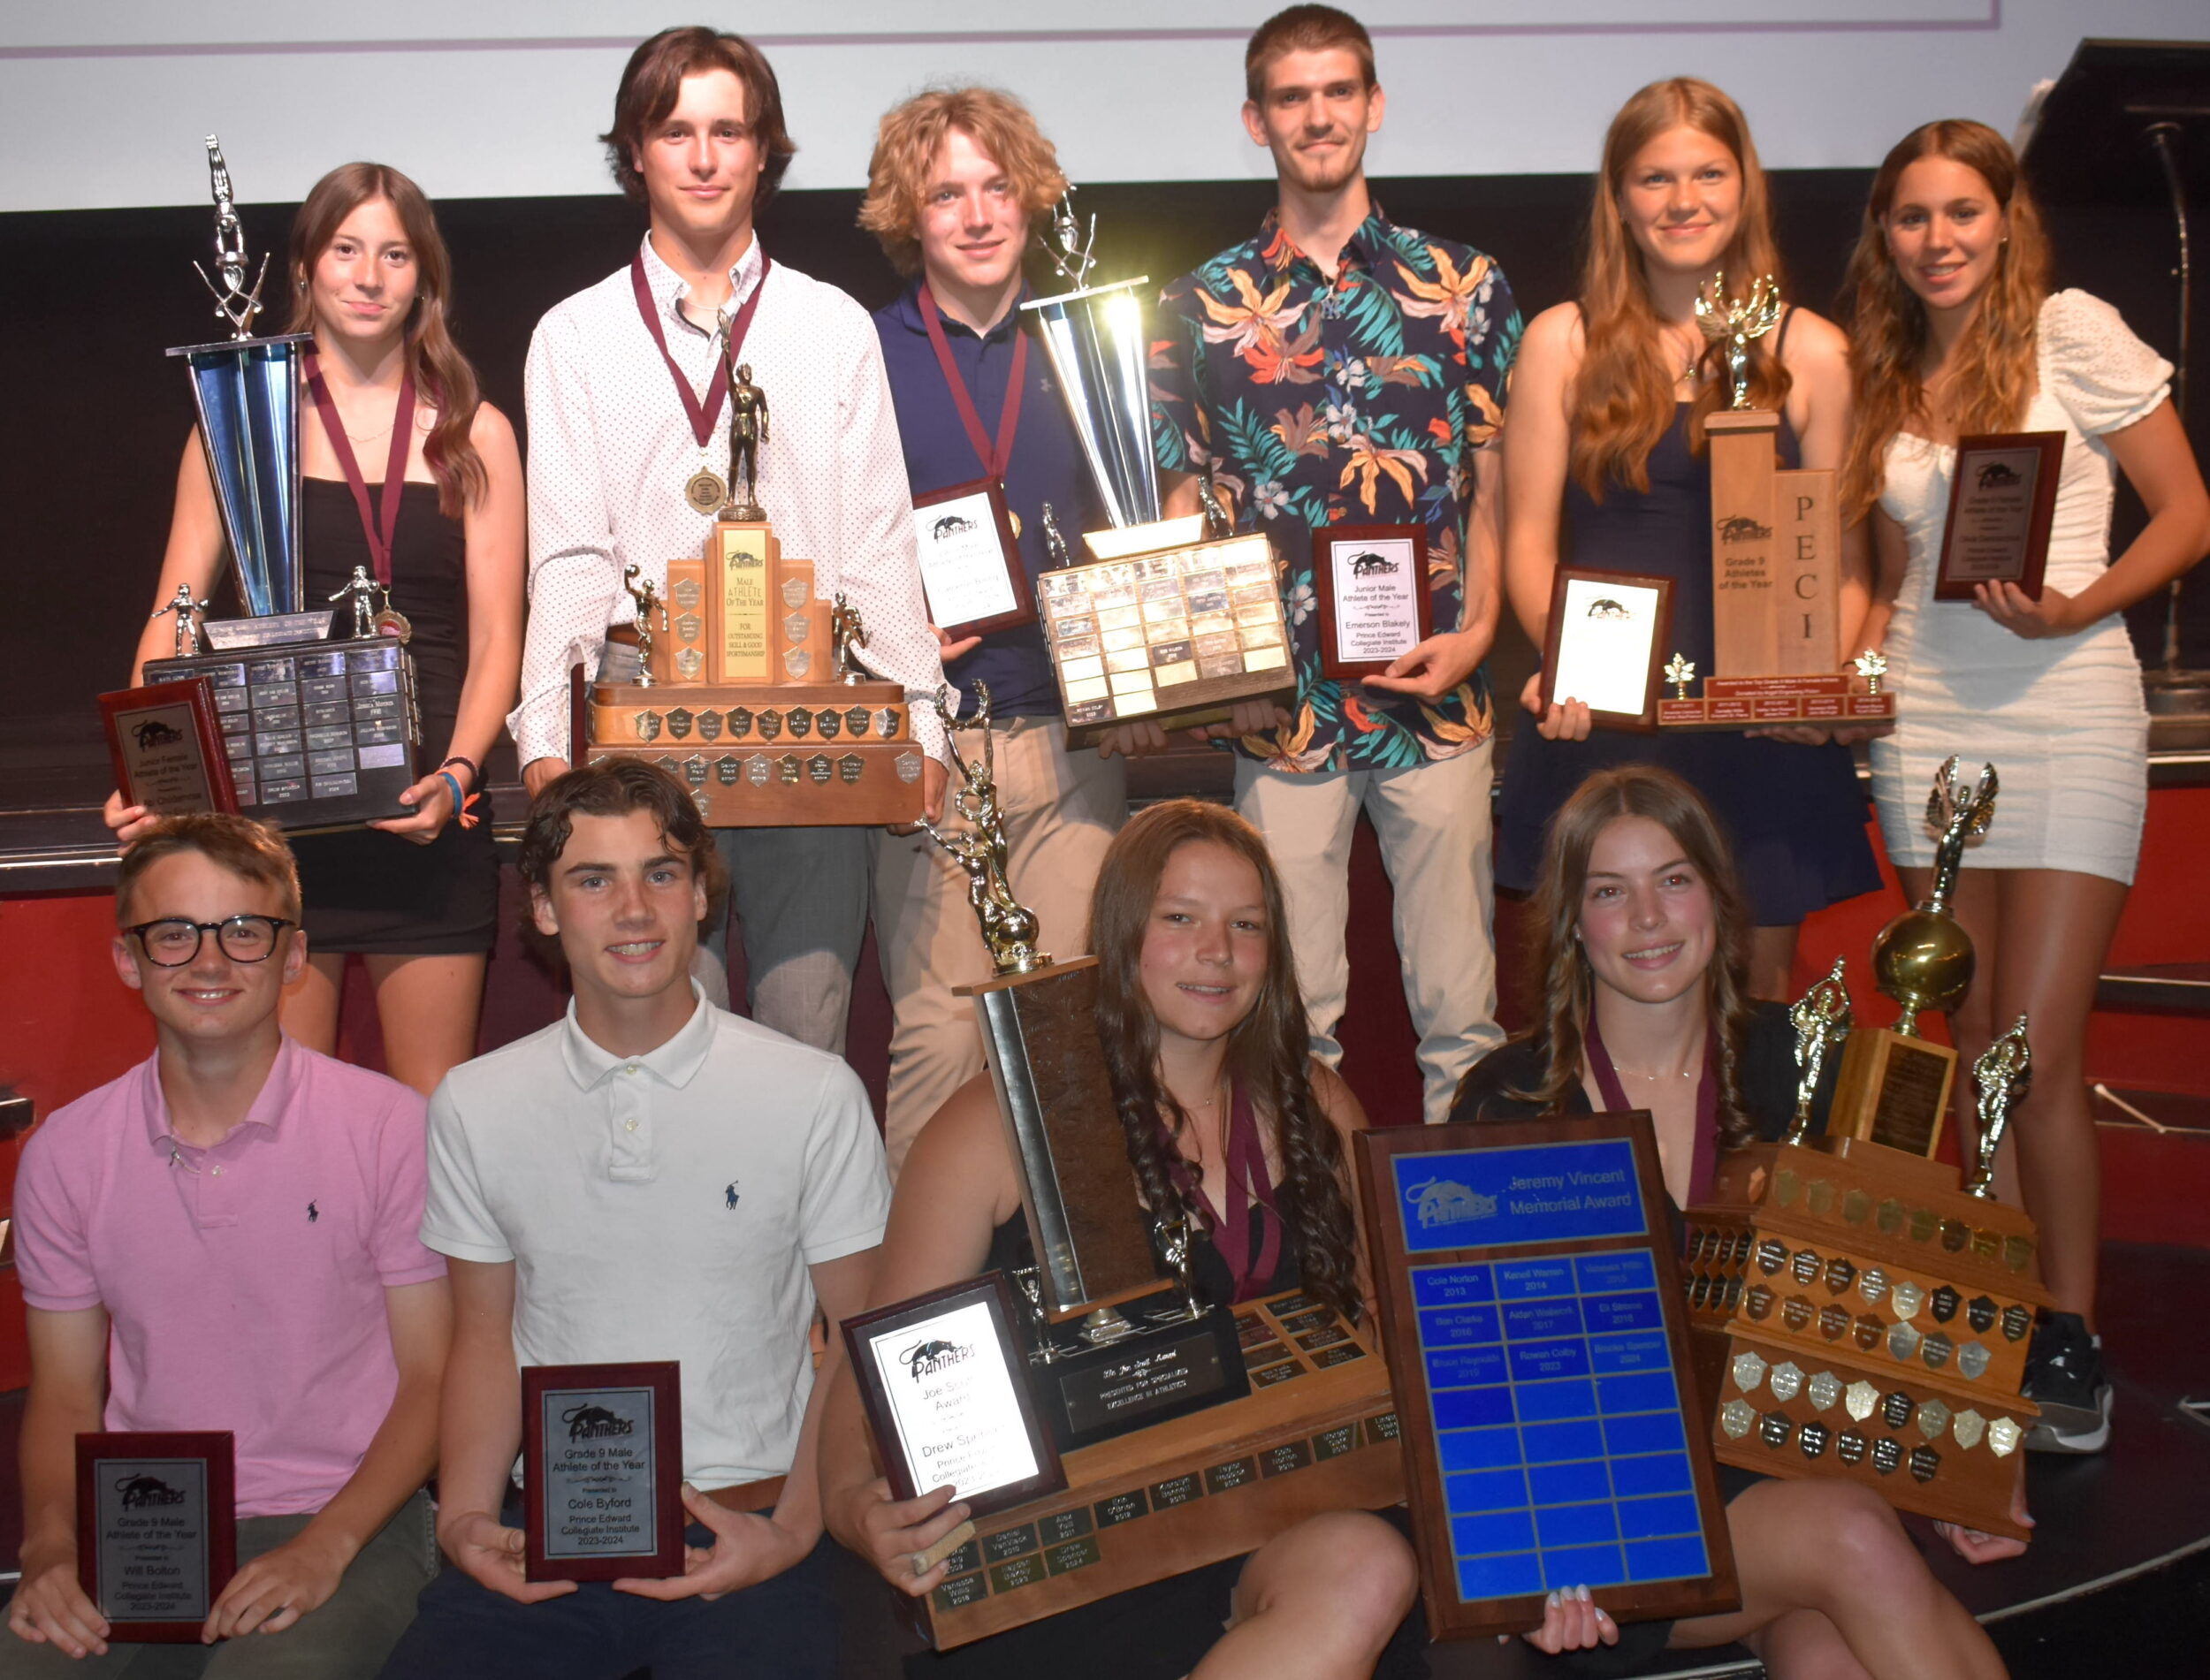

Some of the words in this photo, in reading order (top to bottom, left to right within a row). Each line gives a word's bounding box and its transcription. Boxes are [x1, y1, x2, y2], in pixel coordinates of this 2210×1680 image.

[934, 520, 978, 544] PANTHERS
[729, 558, 764, 571] PANTHERS
[1353, 563, 1399, 579] PANTHERS
[1509, 1173, 1564, 1190] Jeremy
[1567, 1169, 1625, 1186] Vincent
[1510, 1197, 1581, 1215] Memorial
[1584, 1193, 1632, 1209] Award
[1525, 1281, 1547, 1290] 2014
[911, 1344, 976, 1383] PANTHERS
[922, 1388, 943, 1400] Joe
[569, 1419, 634, 1443] PANTHERS
[565, 1450, 596, 1459] Grade
[608, 1448, 632, 1457] Male
[922, 1440, 954, 1457] Drew
[553, 1463, 588, 1472] Athlete
[591, 1462, 601, 1471] of
[604, 1462, 619, 1471] the
[622, 1461, 644, 1470] Year
[123, 1490, 186, 1512] PANTHERS
[568, 1499, 593, 1509] Cole
[597, 1498, 631, 1510] Byford
[118, 1518, 149, 1527] Grade
[153, 1517, 157, 1526] 9
[161, 1517, 184, 1526] Male
[106, 1531, 140, 1539] Athlete
[143, 1530, 153, 1539] of
[174, 1530, 197, 1539] Year
[561, 1526, 604, 1536] Collegiate
[996, 1531, 1020, 1542] Daniel
[1002, 1547, 1019, 1556] 2010
[125, 1567, 143, 1576] Will
[147, 1567, 180, 1576] Bolton
[115, 1592, 156, 1601] Collegiate
